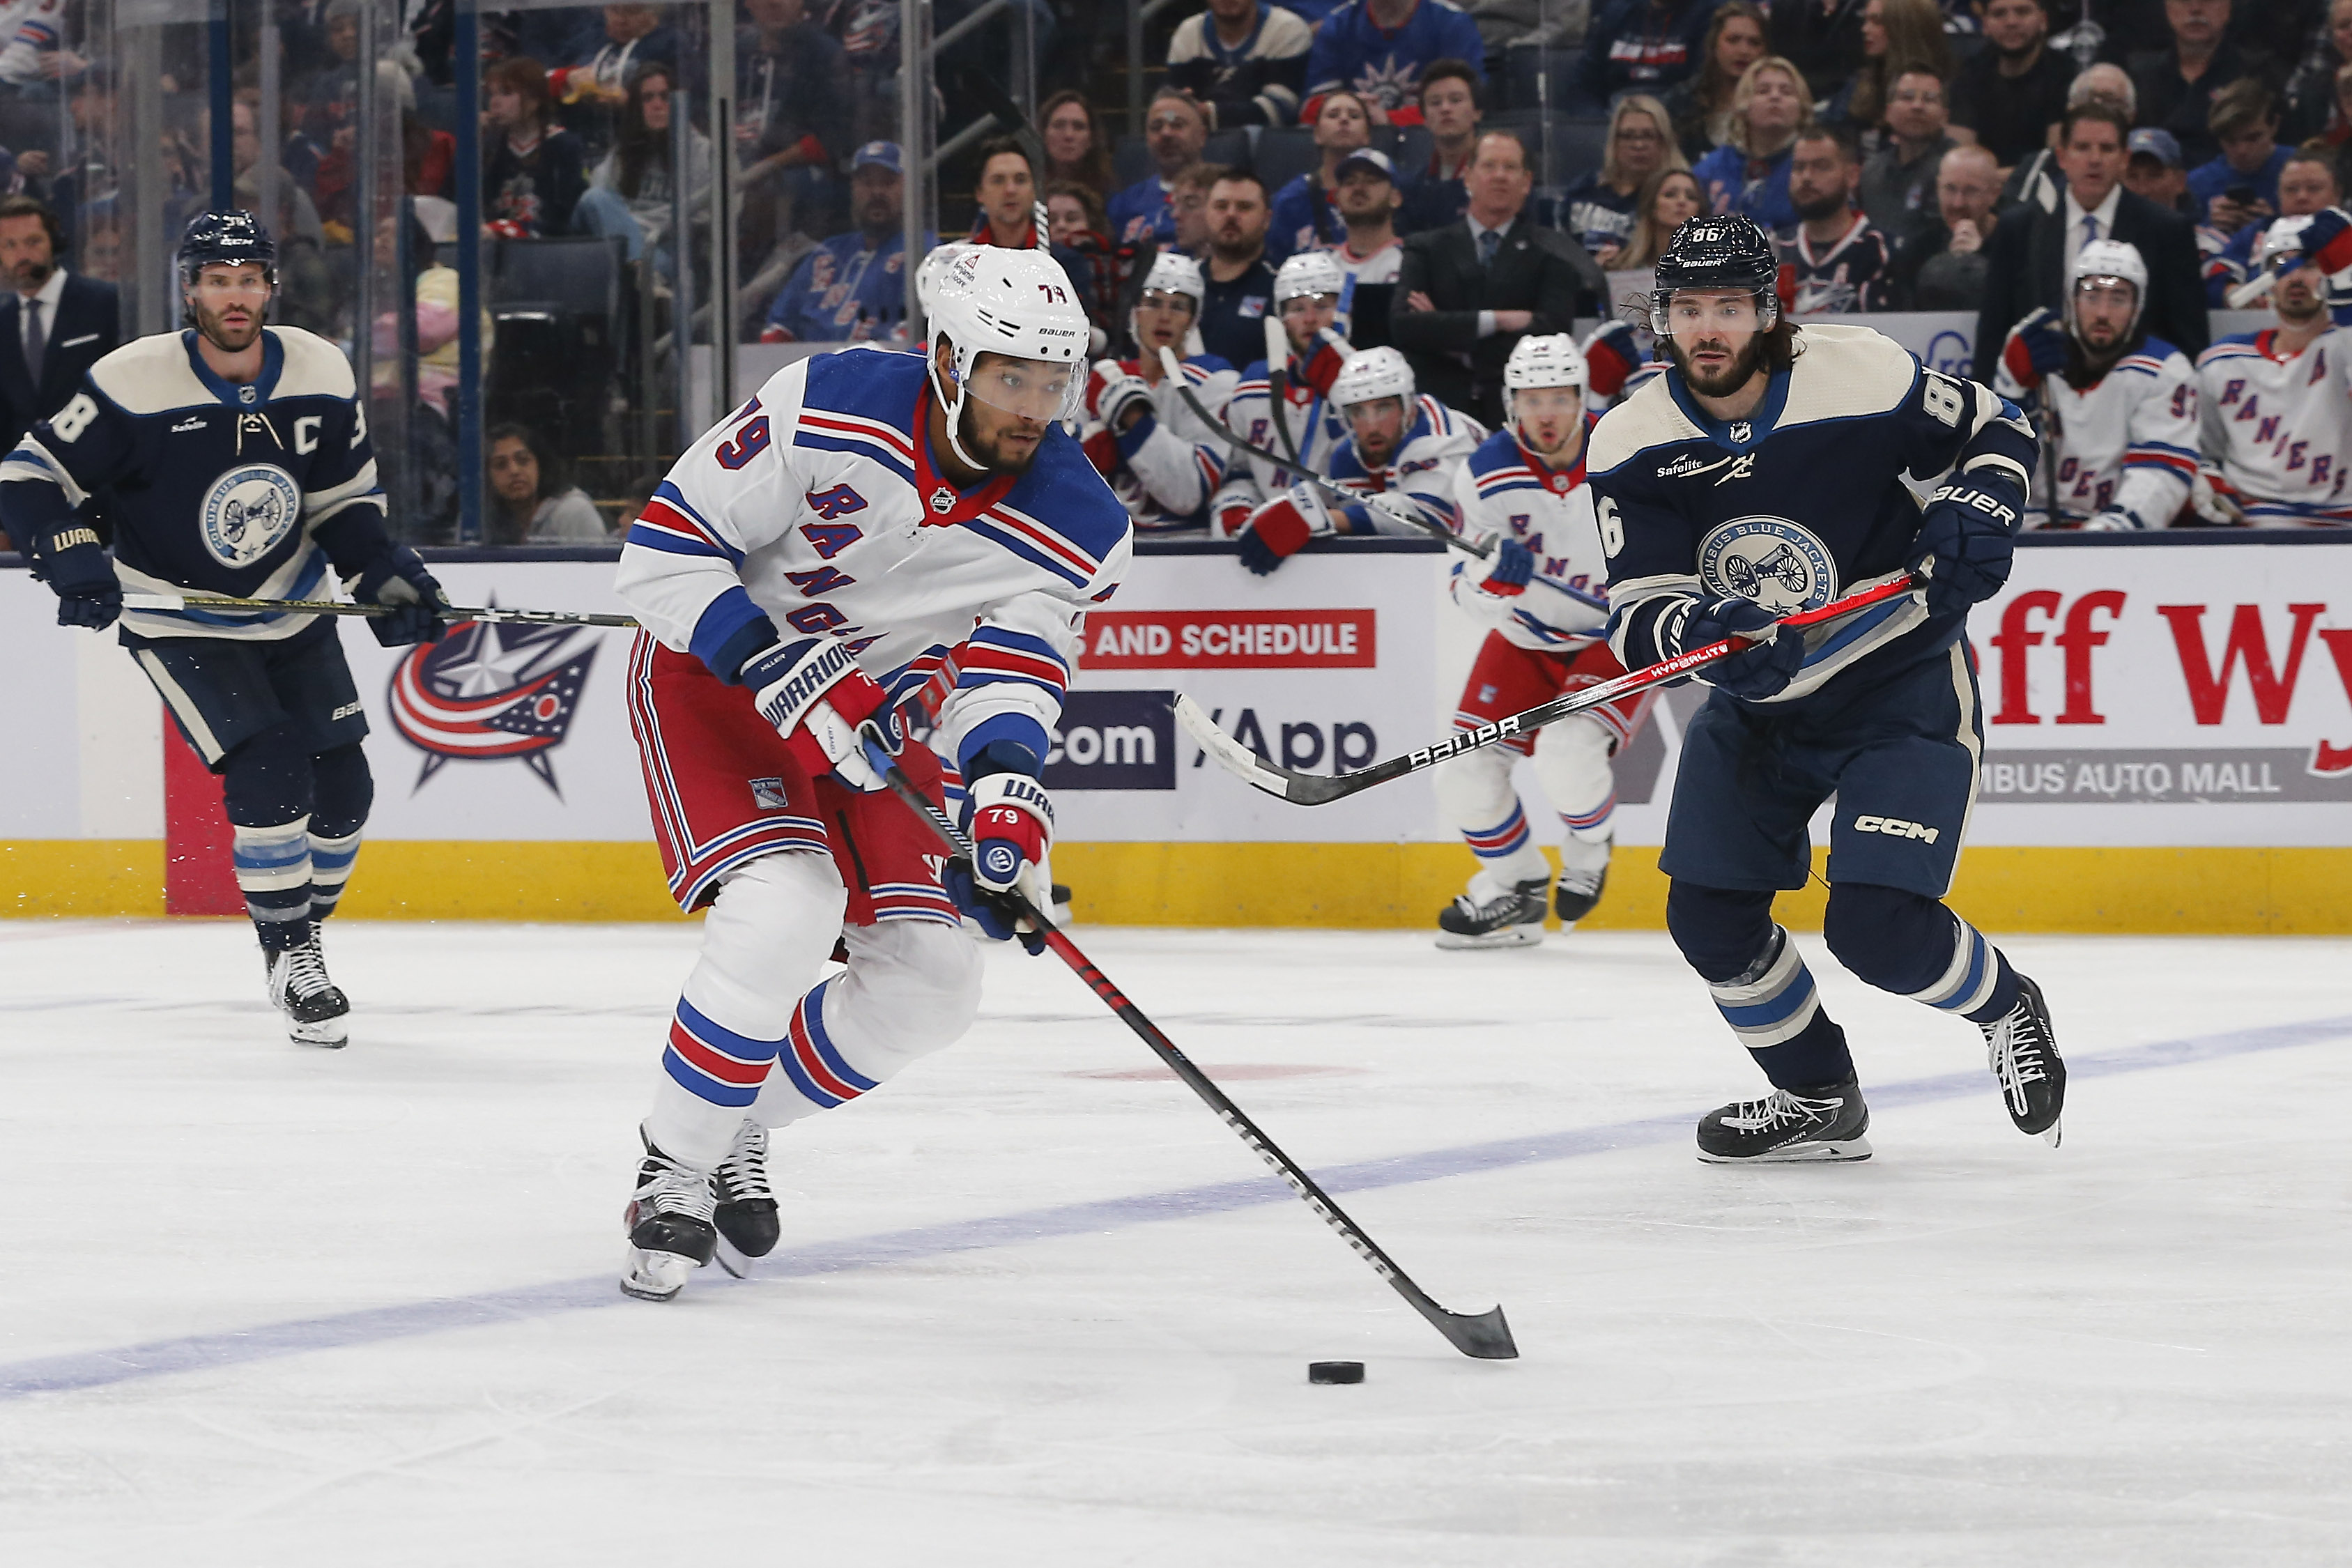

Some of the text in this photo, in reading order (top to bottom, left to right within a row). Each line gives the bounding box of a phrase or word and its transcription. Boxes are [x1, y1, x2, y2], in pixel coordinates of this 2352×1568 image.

[1692, 227, 1721, 243] 86
[1682, 260, 1722, 268] BAUER
[1038, 284, 1068, 304] 79
[1038, 327, 1077, 338] BAUER
[1922, 364, 1966, 429] 8
[48, 392, 100, 444] 8
[293, 415, 323, 456] C
[1656, 460, 1703, 477] Safelite
[1597, 495, 1625, 560] 6
[783, 483, 890, 656] RANG
[1704, 523, 1829, 604] COLUMBUS BLUE JACKETS
[1095, 624, 1173, 656] AND
[1181, 622, 1358, 656] SCHEDULE
[1969, 590, 2128, 725] ff
[762, 642, 856, 730] WARRIOR
[855, 670, 879, 687] 7
[1408, 715, 1521, 772] BAUER
[2073, 762, 2173, 794] AUTO
[2181, 762, 2282, 794] MALL
[987, 808, 1019, 824] 79
[1854, 815, 1939, 845] CCM
